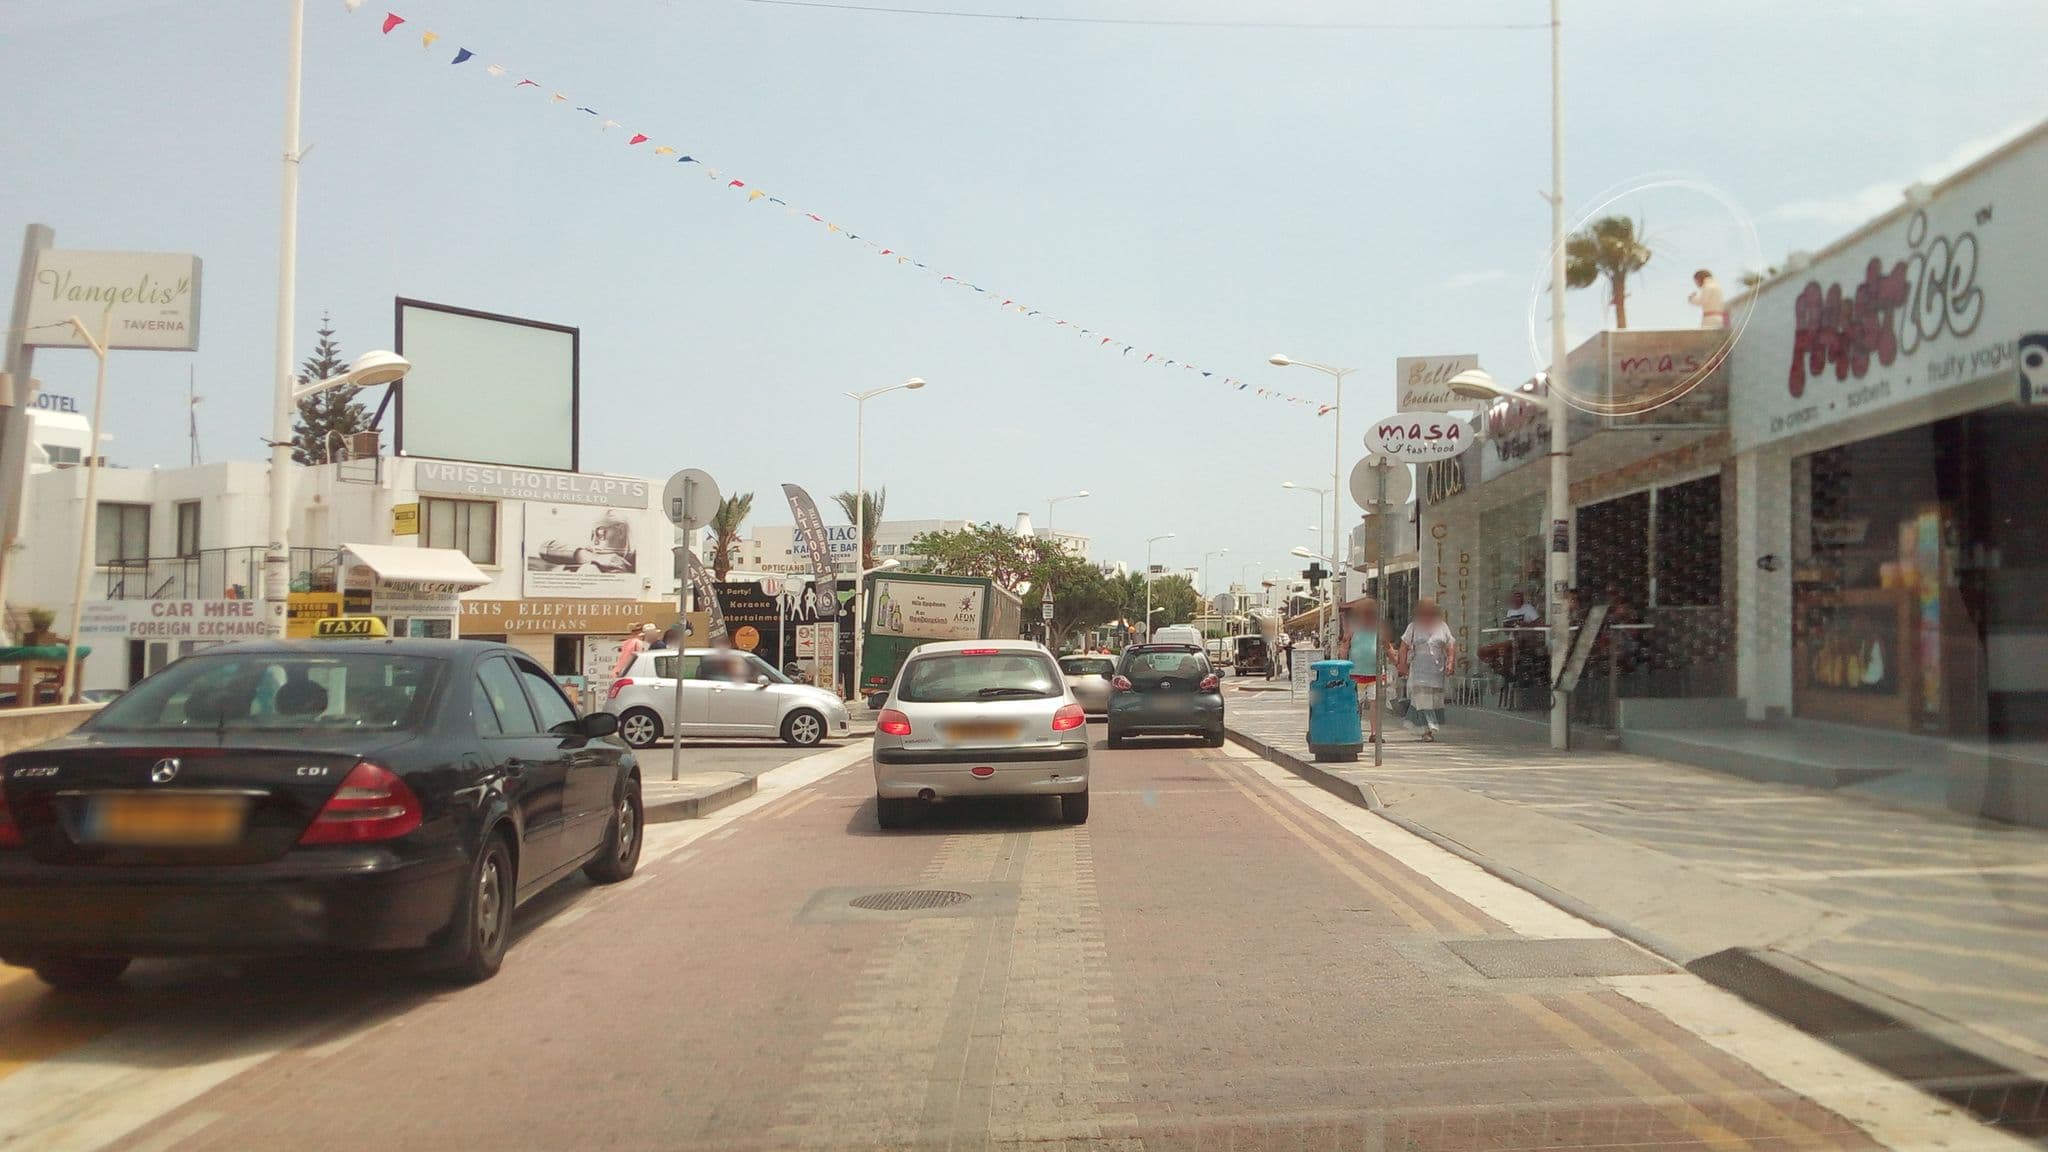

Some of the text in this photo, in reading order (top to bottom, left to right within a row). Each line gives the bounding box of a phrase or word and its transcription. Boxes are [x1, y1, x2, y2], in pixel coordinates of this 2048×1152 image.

[38, 268, 174, 314] Vangelis
[122, 319, 185, 331] TAVERNA
[1408, 360, 1465, 385] Bell'
[27, 392, 79, 413] OTEL
[1378, 423, 1460, 440] masa
[1405, 443, 1455, 455] fast food
[423, 464, 646, 498] VRISSI HOTEL APTS
[794, 526, 857, 542] ZIAC
[761, 563, 805, 572] OPTICIANS
[151, 602, 254, 617] CAR HIRE
[518, 603, 645, 617] ELEFTHERIOU
[129, 621, 191, 636] FOREIGN
[199, 621, 265, 636] EXCHANG
[323, 620, 369, 634] TAXI
[504, 619, 588, 630] OPTICIANS
[296, 765, 329, 776] CDI
